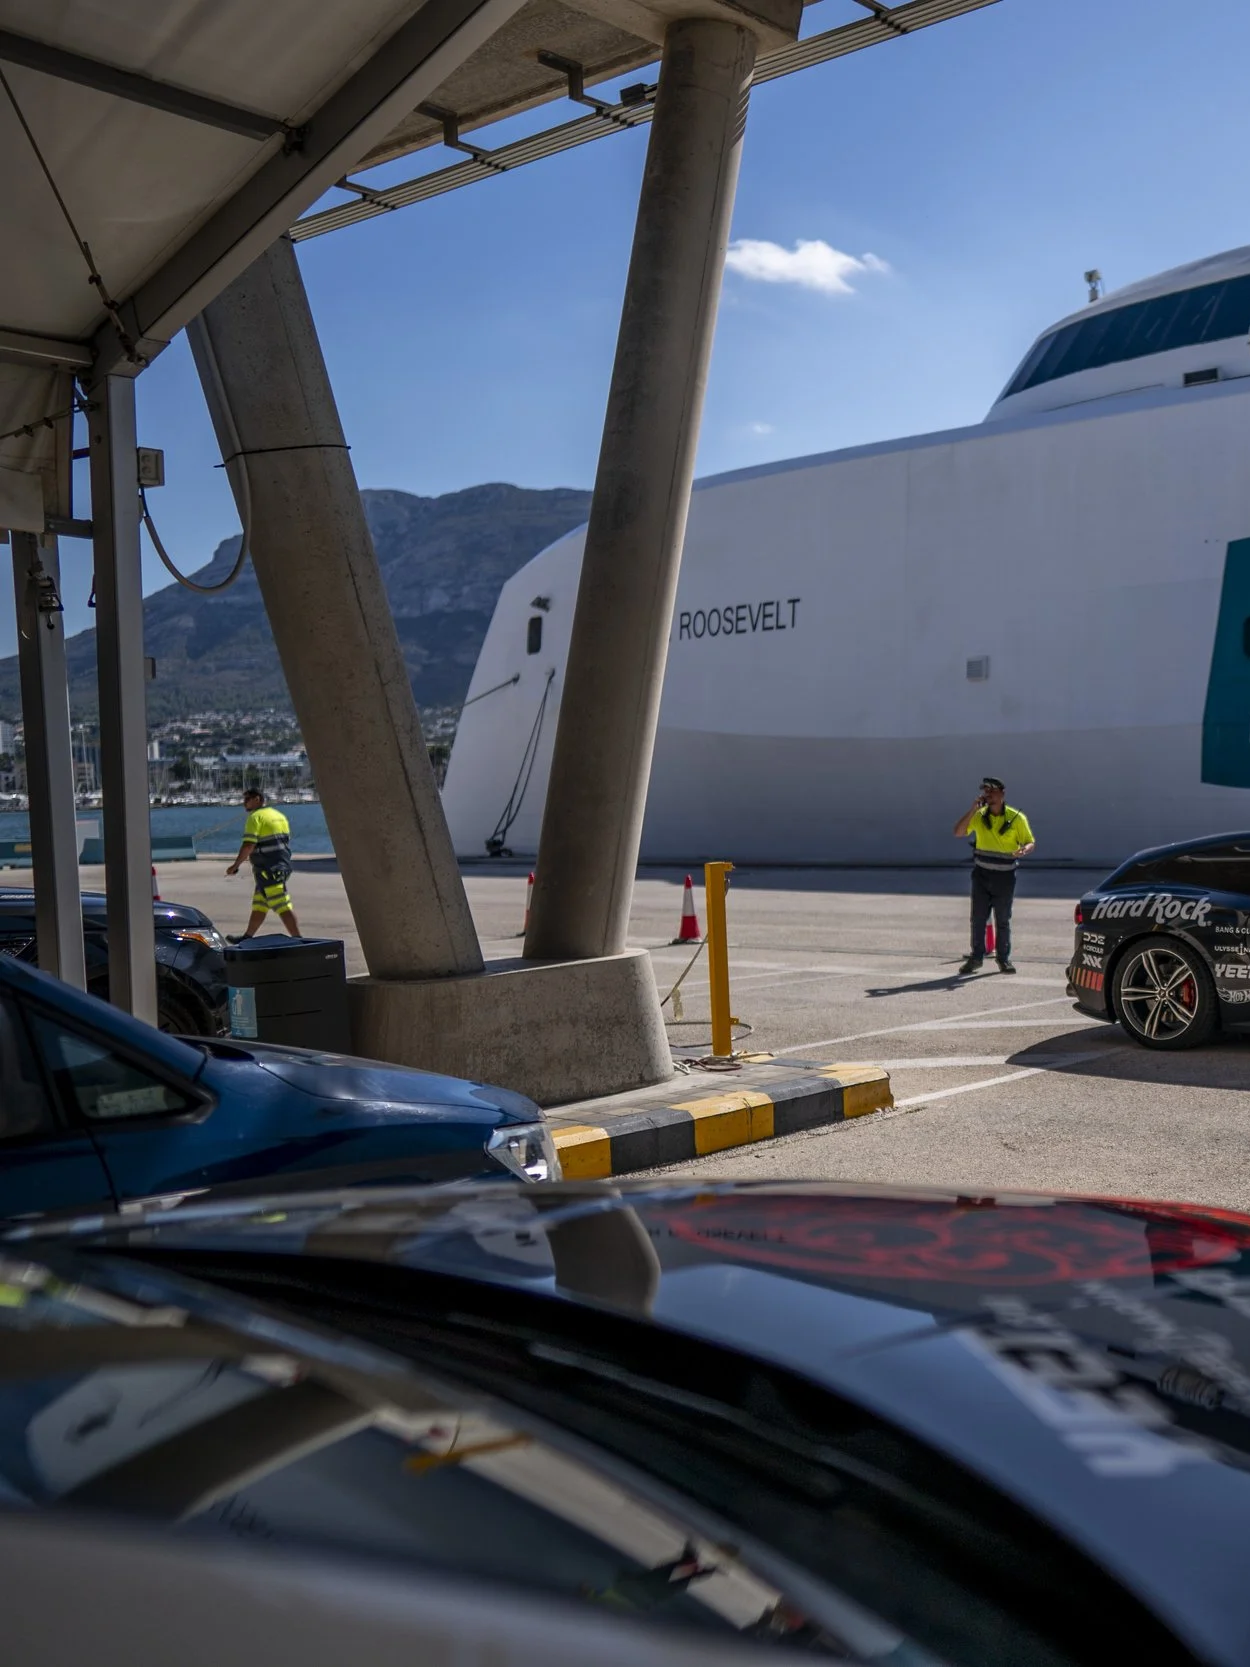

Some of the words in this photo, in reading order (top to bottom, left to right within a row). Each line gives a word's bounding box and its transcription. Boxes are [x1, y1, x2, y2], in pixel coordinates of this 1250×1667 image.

[679, 598, 800, 640] ROOSEVELT
[1091, 893, 1155, 920] Hard
[1147, 893, 1212, 927] Rock
[1215, 926, 1234, 934] BANG
[1235, 926, 1240, 934] &
[1214, 945, 1239, 953] ULYSSE
